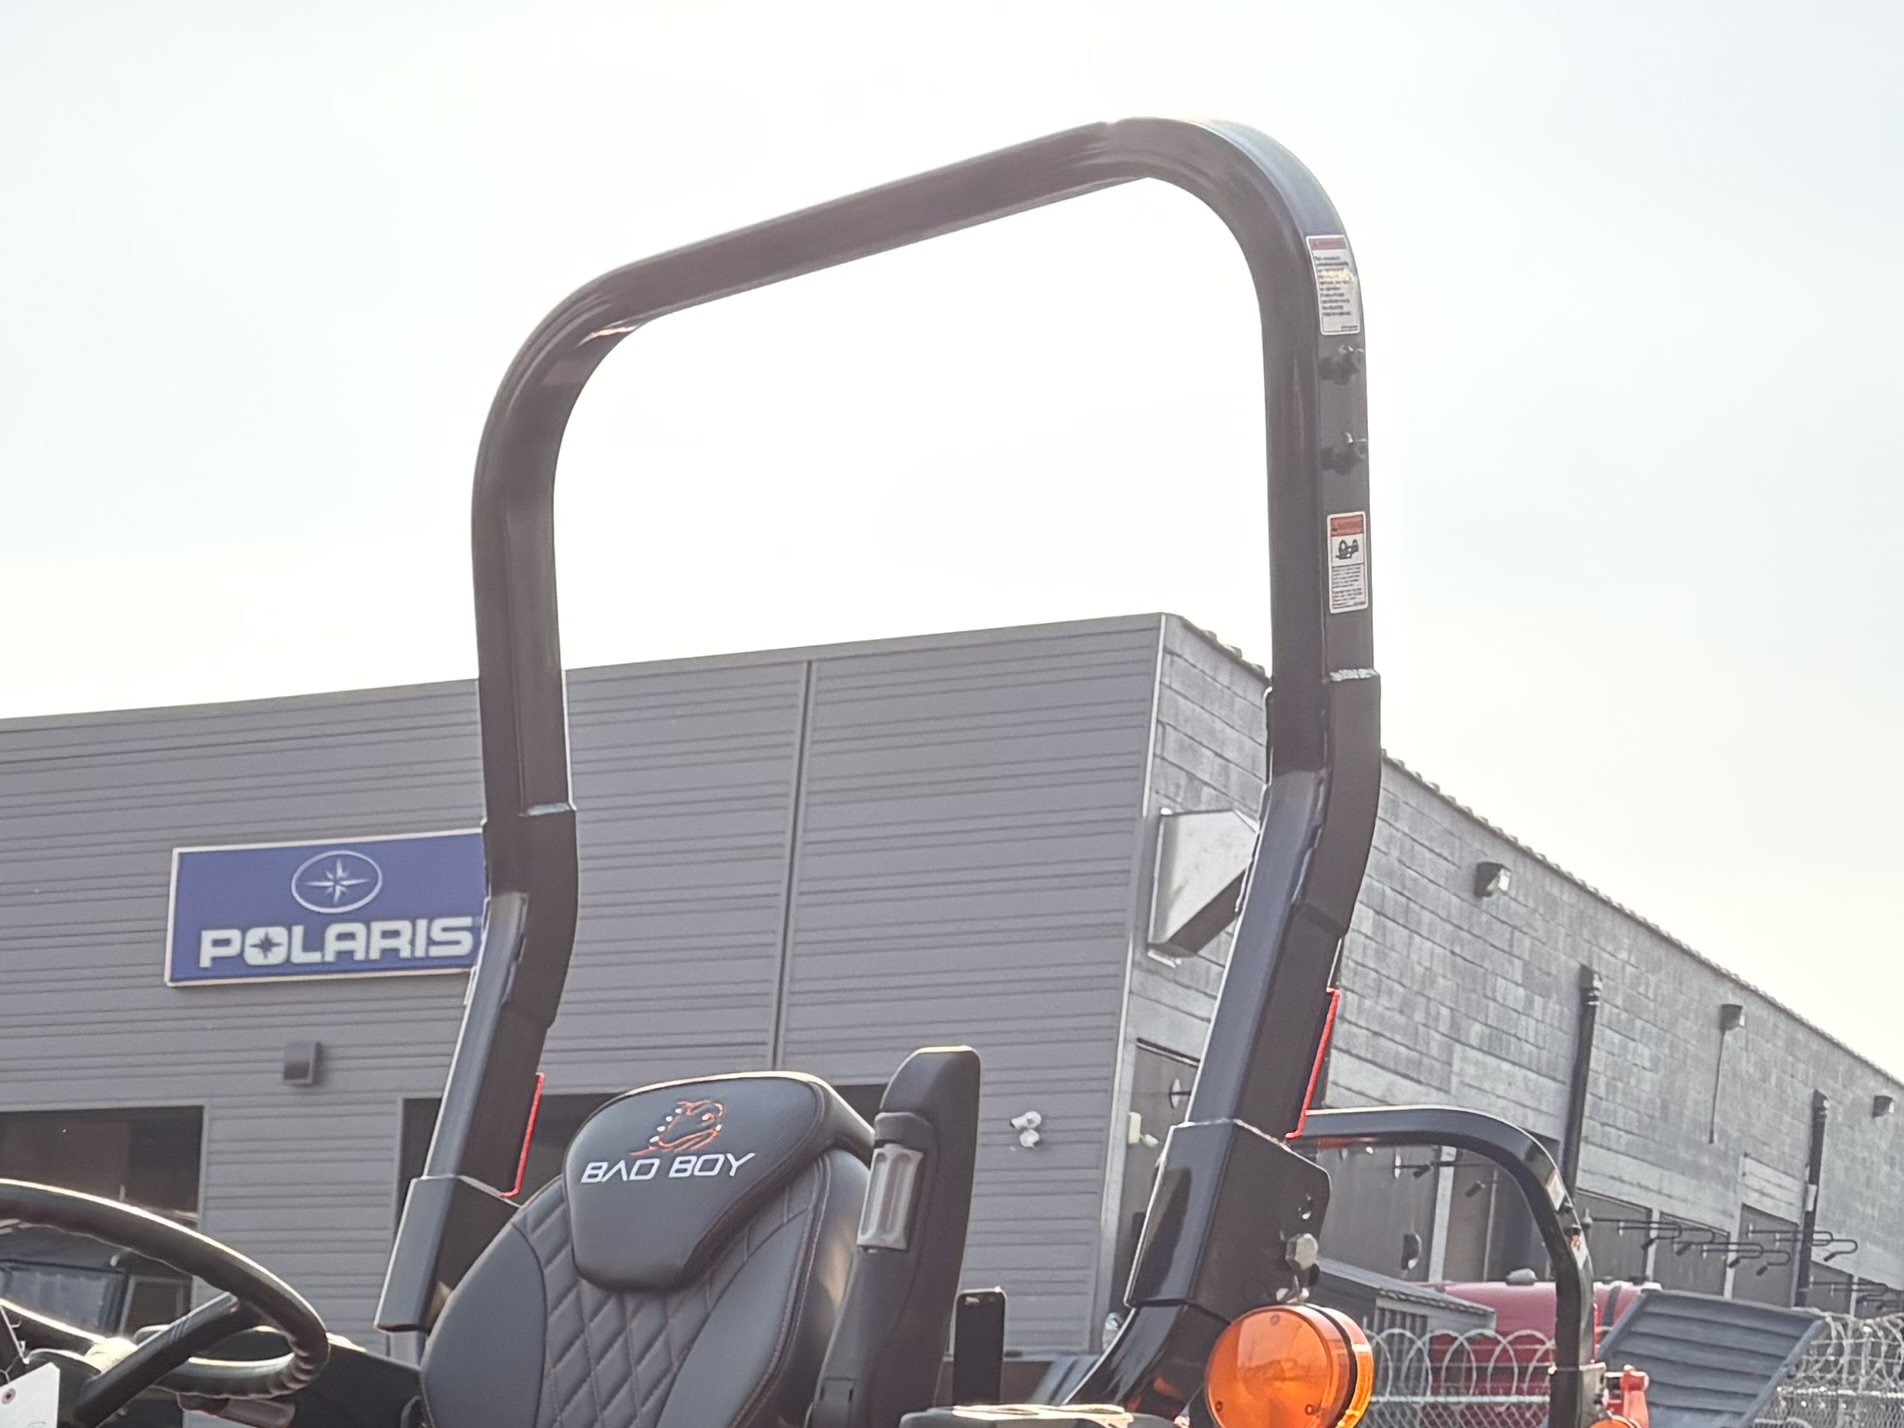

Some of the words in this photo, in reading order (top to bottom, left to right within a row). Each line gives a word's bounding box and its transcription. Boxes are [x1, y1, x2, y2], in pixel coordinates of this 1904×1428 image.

[199, 916, 474, 968] POLARIS
[580, 1158, 660, 1183] BAD
[668, 1152, 756, 1178] BOY
